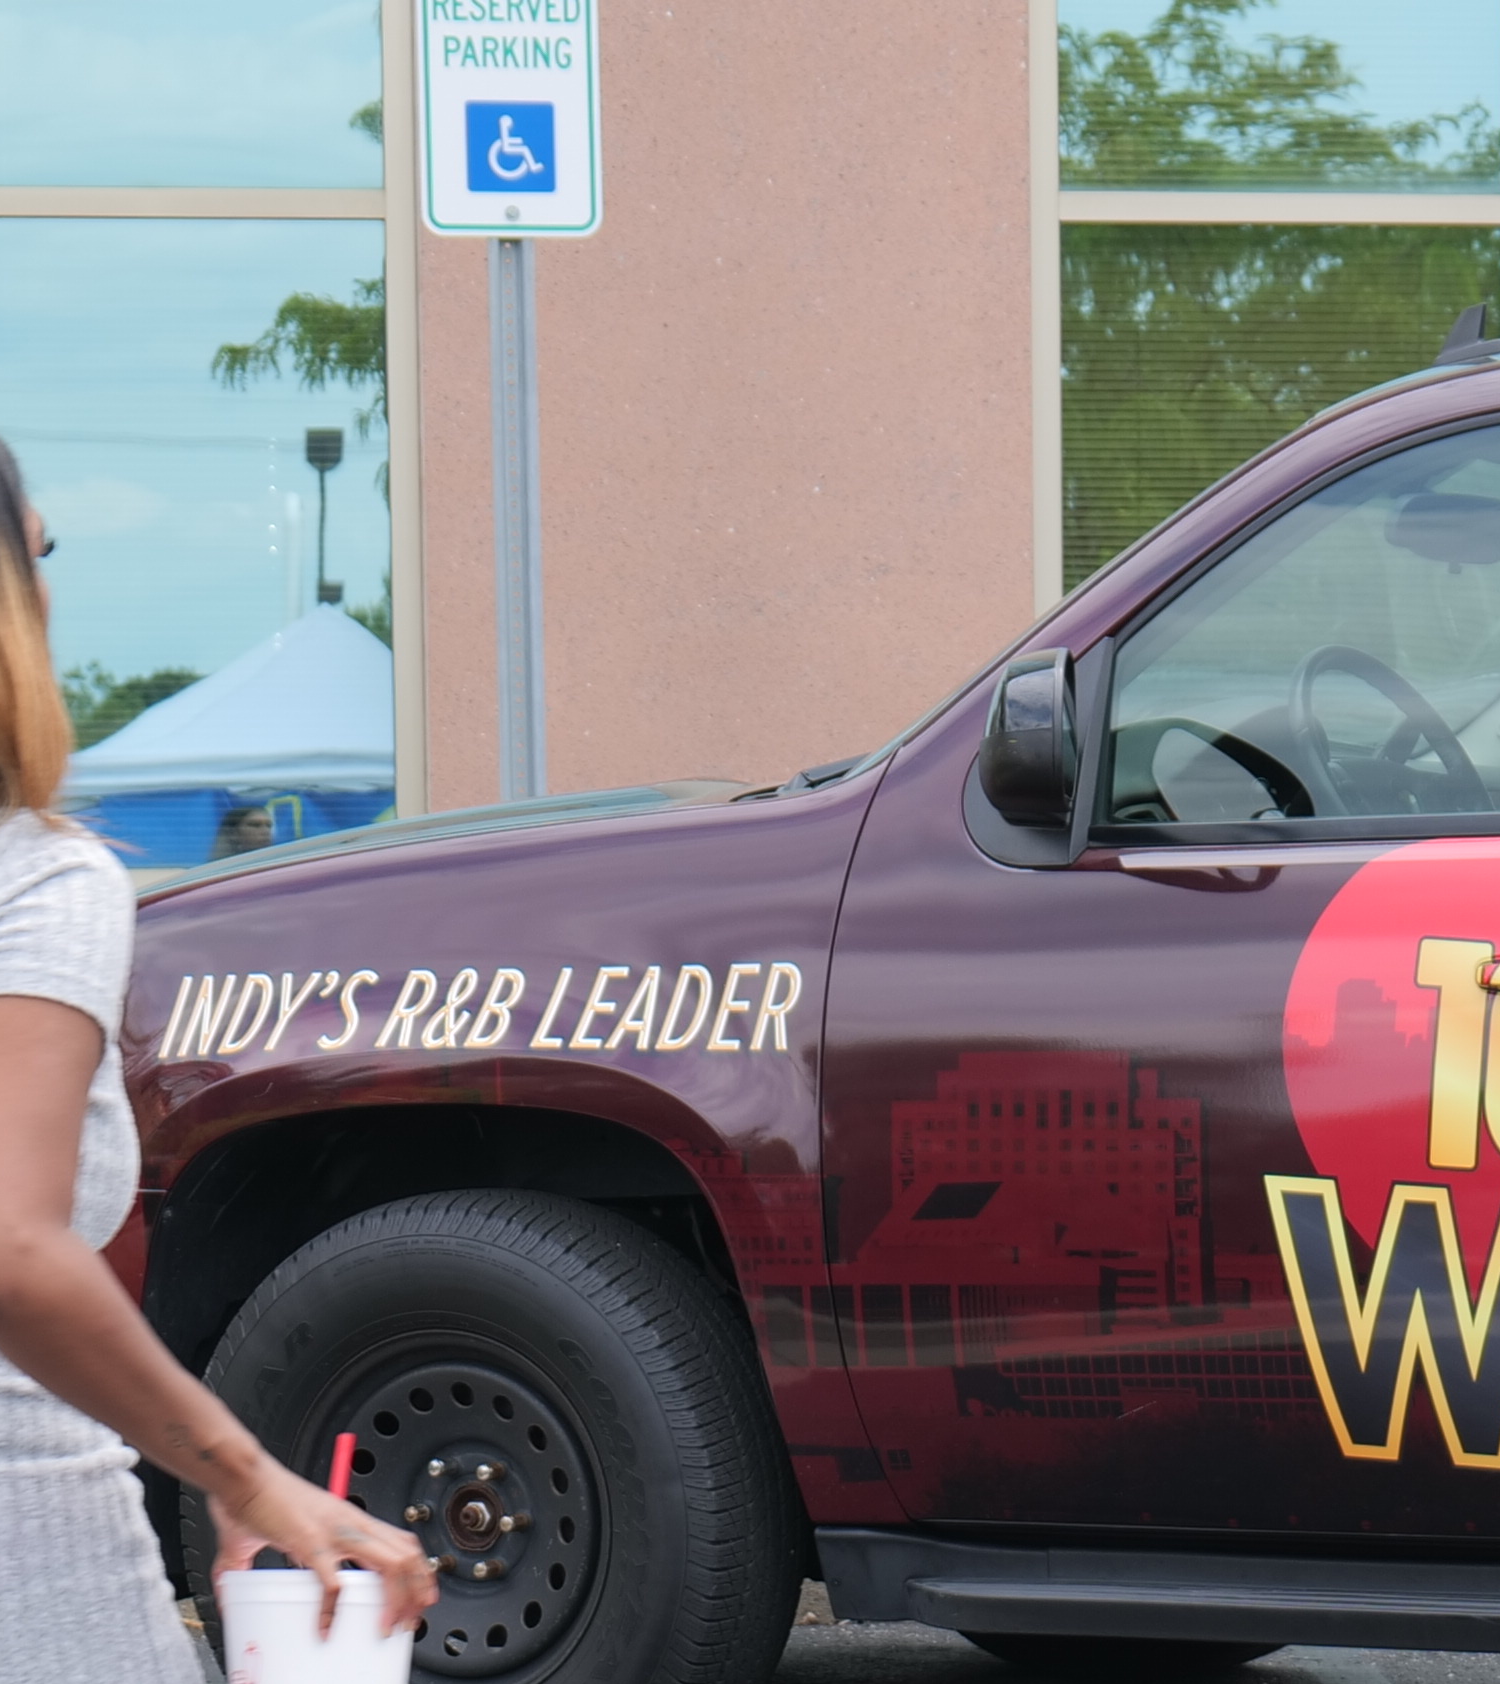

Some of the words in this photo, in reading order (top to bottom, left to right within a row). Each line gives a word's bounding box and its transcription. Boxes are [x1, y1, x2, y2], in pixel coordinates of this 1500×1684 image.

[432, 0, 581, 22] RESERVED
[443, 36, 572, 69] PARKING
[159, 971, 377, 1058] INDY'S
[375, 967, 525, 1049] R&B
[530, 962, 802, 1053] LEADER
